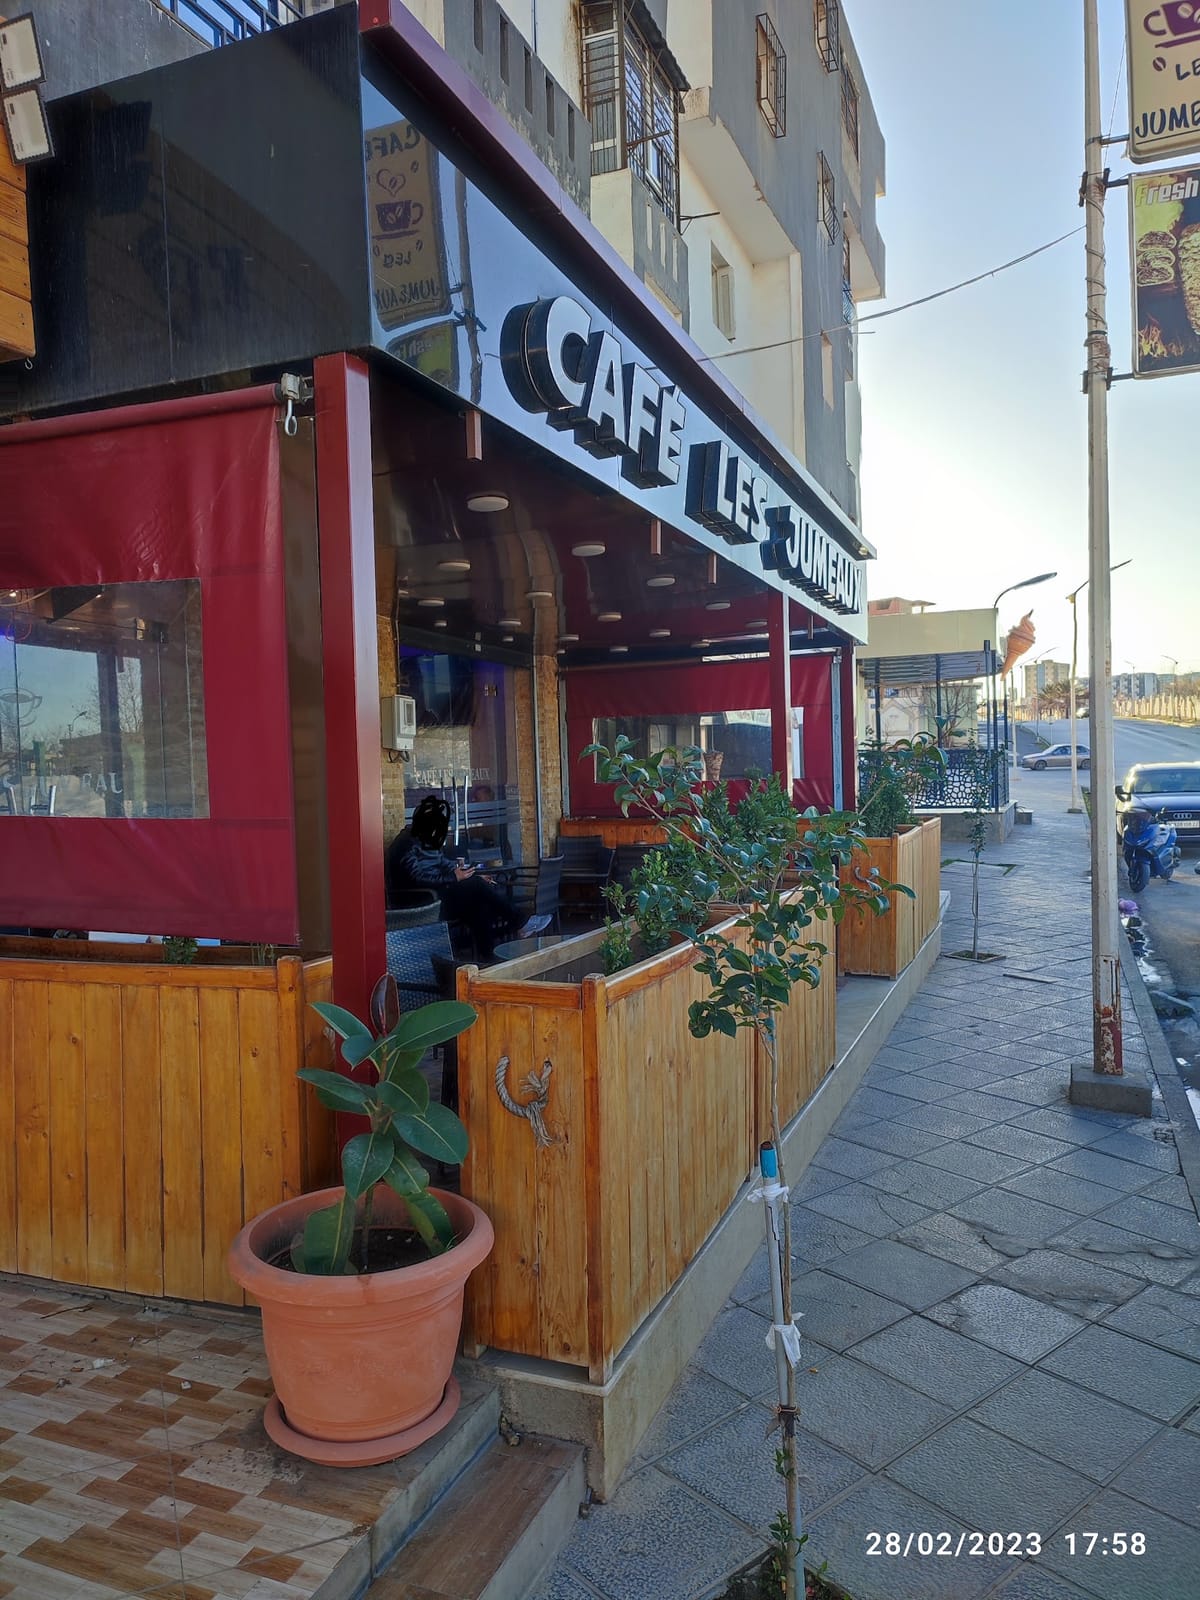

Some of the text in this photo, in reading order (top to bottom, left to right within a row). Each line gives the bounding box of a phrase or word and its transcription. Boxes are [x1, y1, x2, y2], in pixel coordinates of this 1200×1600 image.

[1134, 176, 1199, 207] Fresh
[512, 295, 864, 615] CAFÉ LES JUMEAUX
